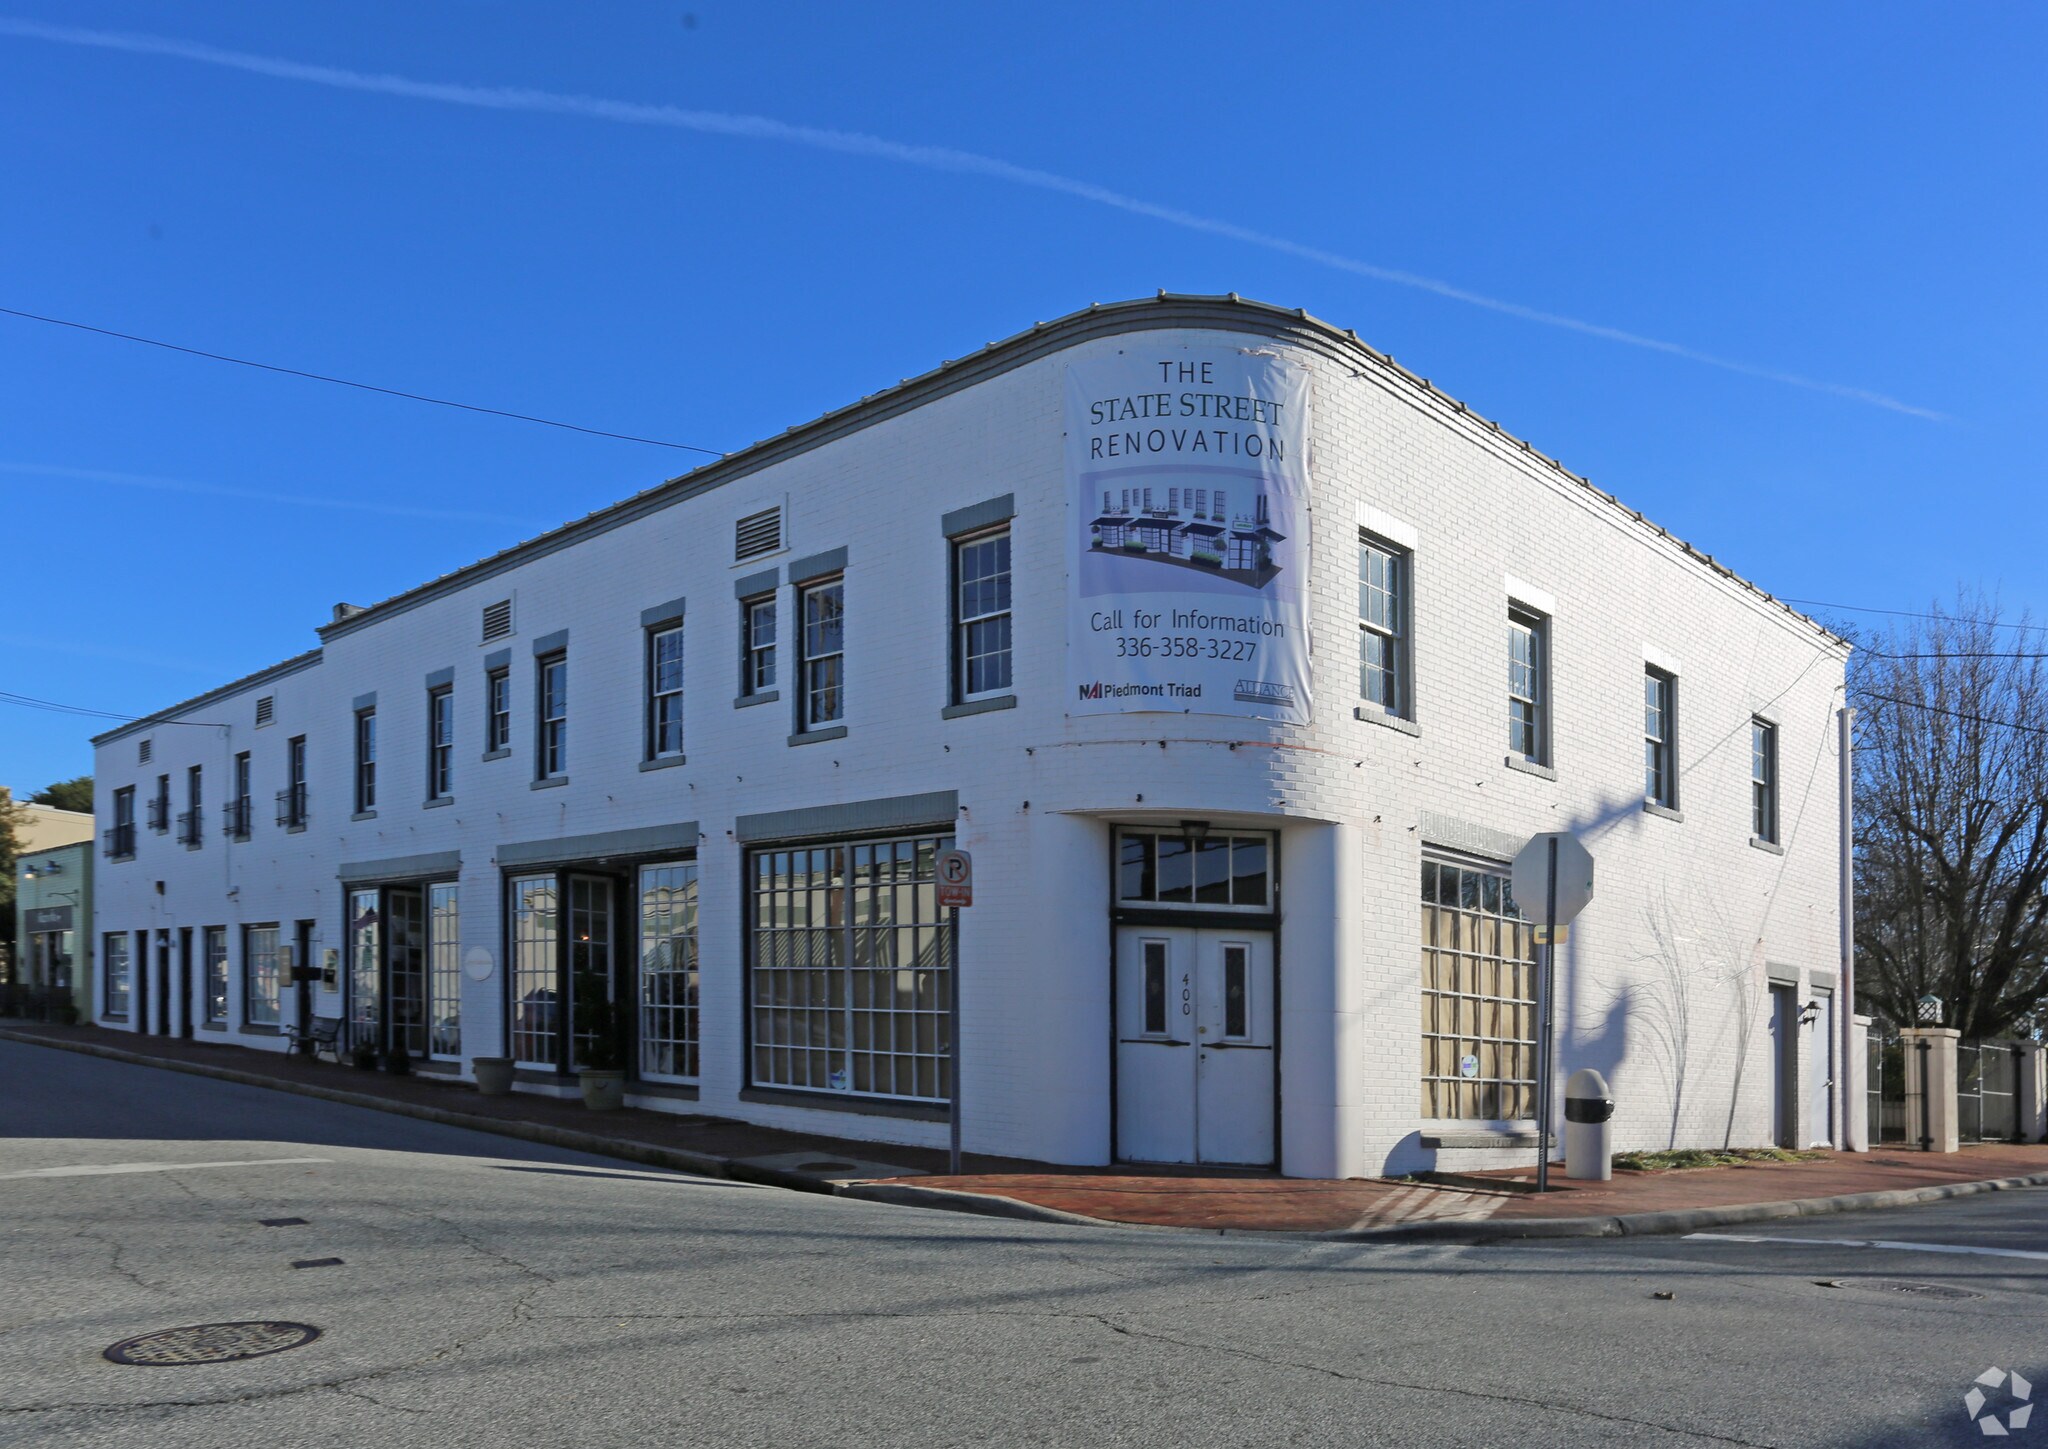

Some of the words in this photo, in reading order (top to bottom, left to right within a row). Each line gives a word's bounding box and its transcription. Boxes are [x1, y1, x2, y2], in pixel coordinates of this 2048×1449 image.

[1158, 361, 1213, 384] THE
[1091, 393, 1172, 425] STATE
[1180, 392, 1283, 426] STREET
[1091, 429, 1284, 461] RENOVATION
[1091, 609, 1123, 632] Call
[1133, 609, 1161, 629] for
[1172, 608, 1285, 638] Information
[1116, 636, 1256, 662] 336-358-3227
[1079, 680, 1102, 700] NAI
[1104, 683, 1163, 698] Piedmont
[1167, 682, 1201, 697] Triad
[1182, 973, 1190, 1015] 400
